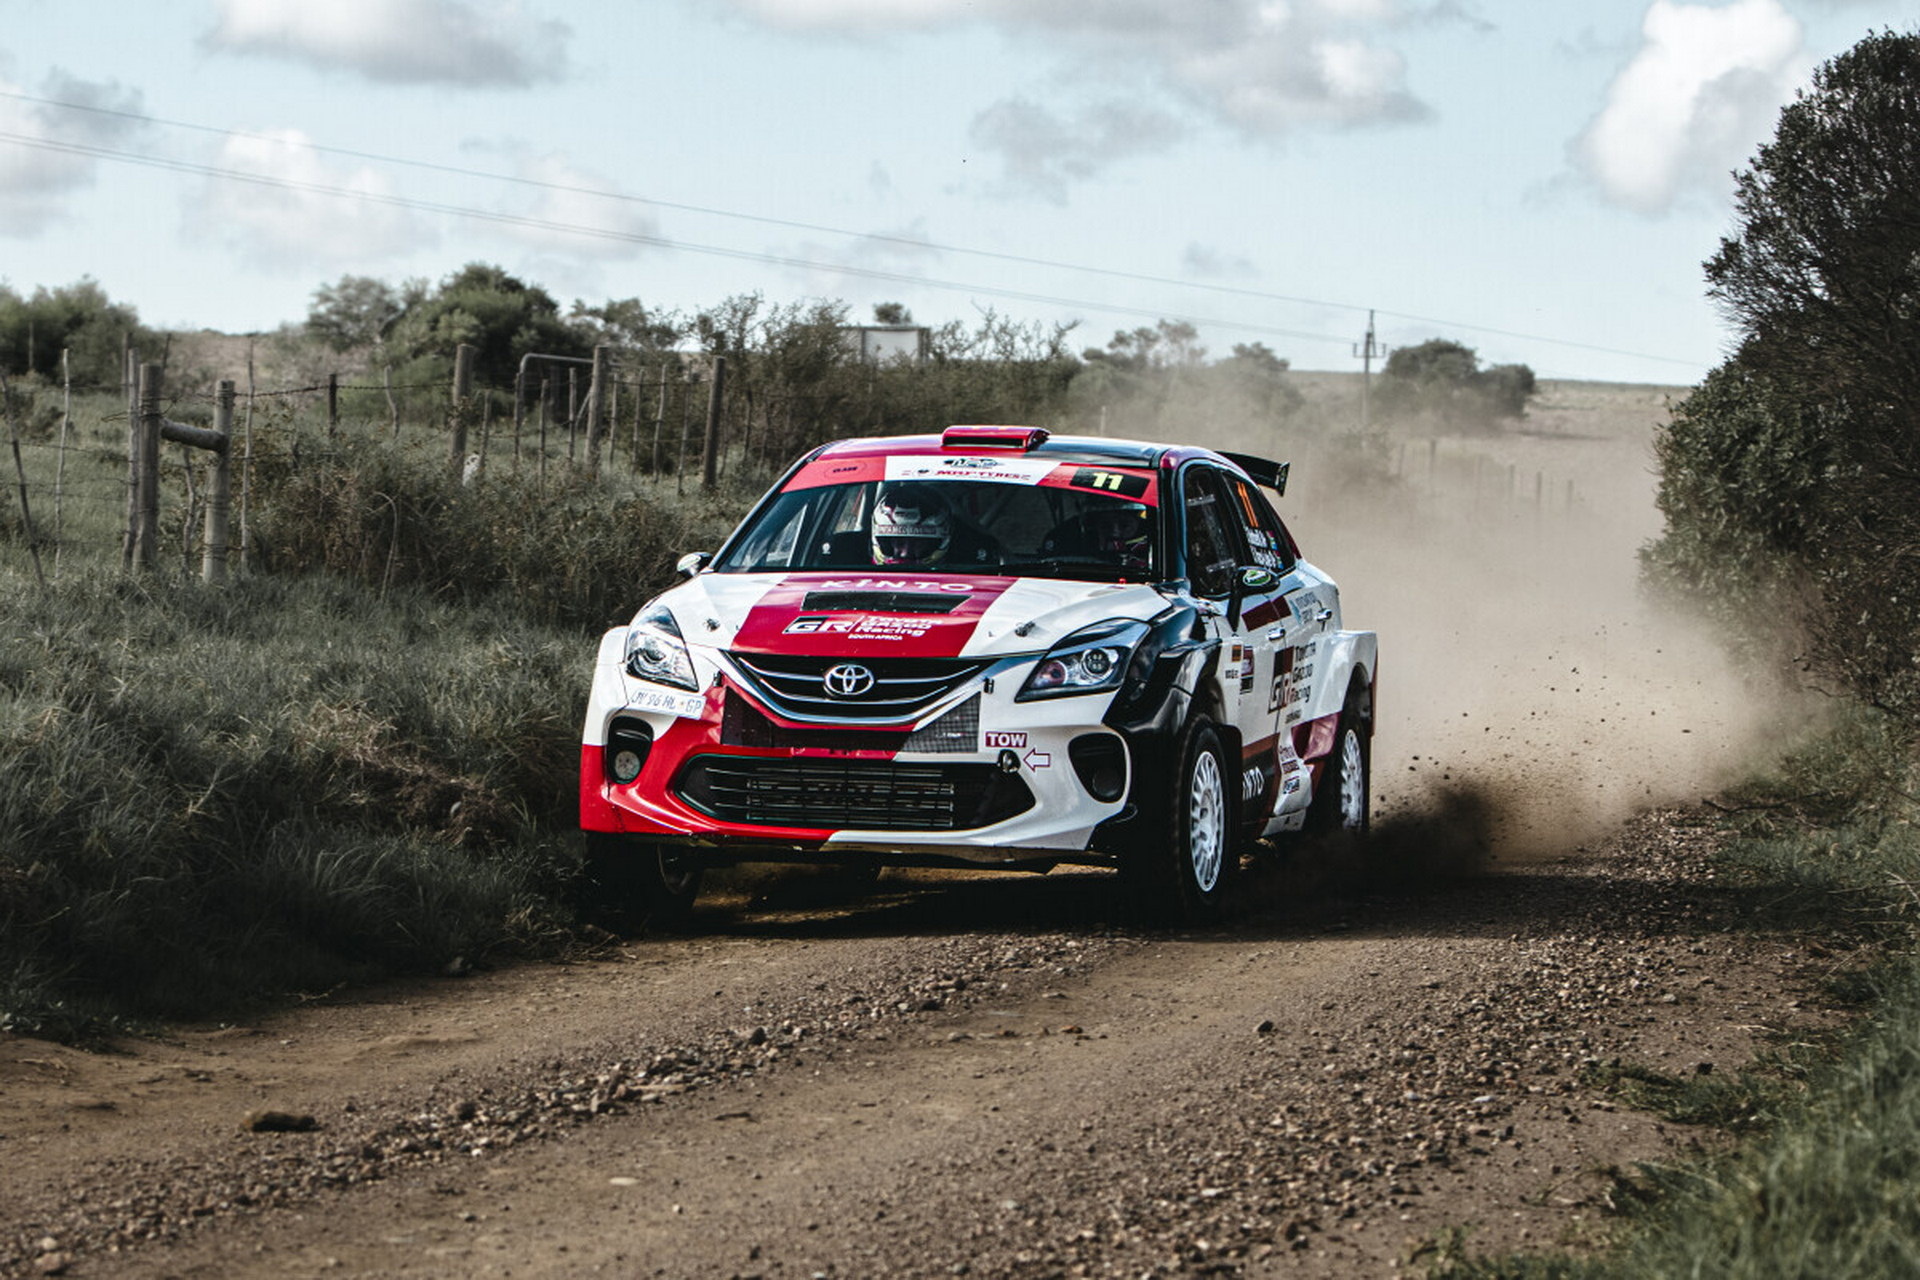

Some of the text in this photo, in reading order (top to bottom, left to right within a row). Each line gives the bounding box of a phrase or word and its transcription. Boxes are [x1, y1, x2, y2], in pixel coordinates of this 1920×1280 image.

[1093, 472, 1124, 491] 11
[821, 579, 974, 591] KINTO
[785, 619, 854, 633] GR
[855, 626, 926, 638] Racing
[685, 698, 702, 714] GP
[987, 733, 1026, 747] TOW
